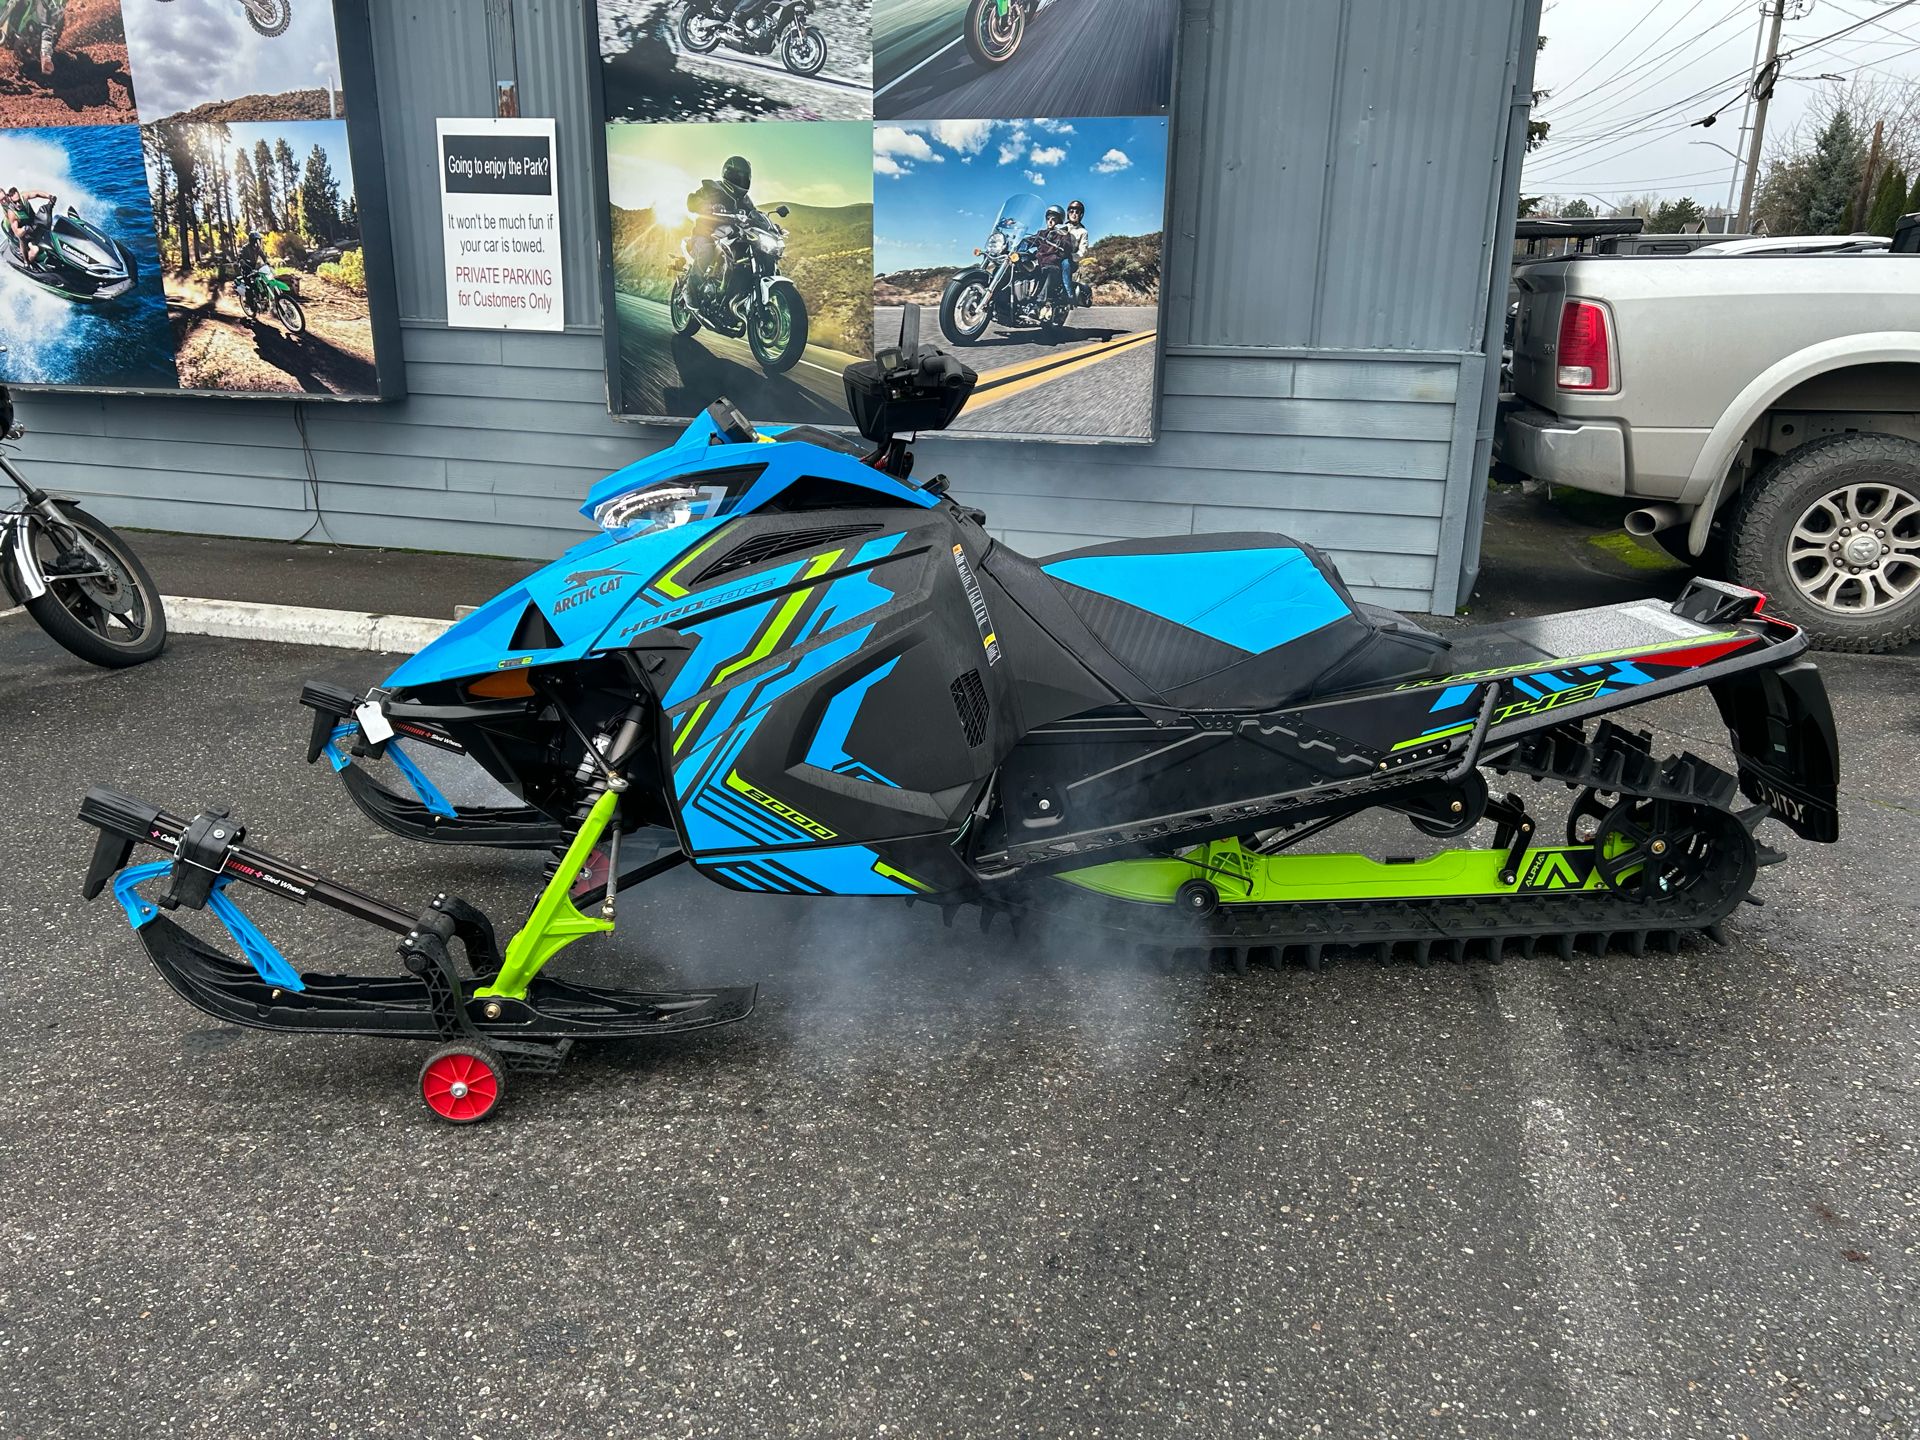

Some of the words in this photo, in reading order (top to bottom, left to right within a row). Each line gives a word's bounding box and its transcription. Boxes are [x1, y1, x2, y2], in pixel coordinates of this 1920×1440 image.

[448, 155, 473, 178] Going
[474, 157, 483, 175] to
[484, 157, 507, 179] enjoy
[508, 157, 522, 175] the
[523, 157, 549, 176] Park?
[448, 213, 454, 229] It
[456, 213, 482, 229] won't
[484, 213, 496, 229] be
[499, 213, 526, 229] much
[528, 213, 544, 230] fun
[547, 213, 554, 230] if
[460, 239, 481, 256] your
[483, 240, 499, 252] car
[501, 236, 510, 253] is
[512, 237, 545, 253] towed.
[456, 266, 500, 284] PRIVATE
[502, 268, 552, 286] PARKING
[458, 290, 471, 306] for
[473, 290, 527, 309] Customers
[528, 292, 552, 314] Only
[553, 585, 597, 617] ARCTIC
[599, 576, 623, 596] CAT
[619, 577, 777, 639] HARDCORE
[743, 788, 836, 839] 8000
[1525, 853, 1546, 888] ALPHA
[263, 874, 280, 886] Sled
[280, 880, 308, 896] Wheels
